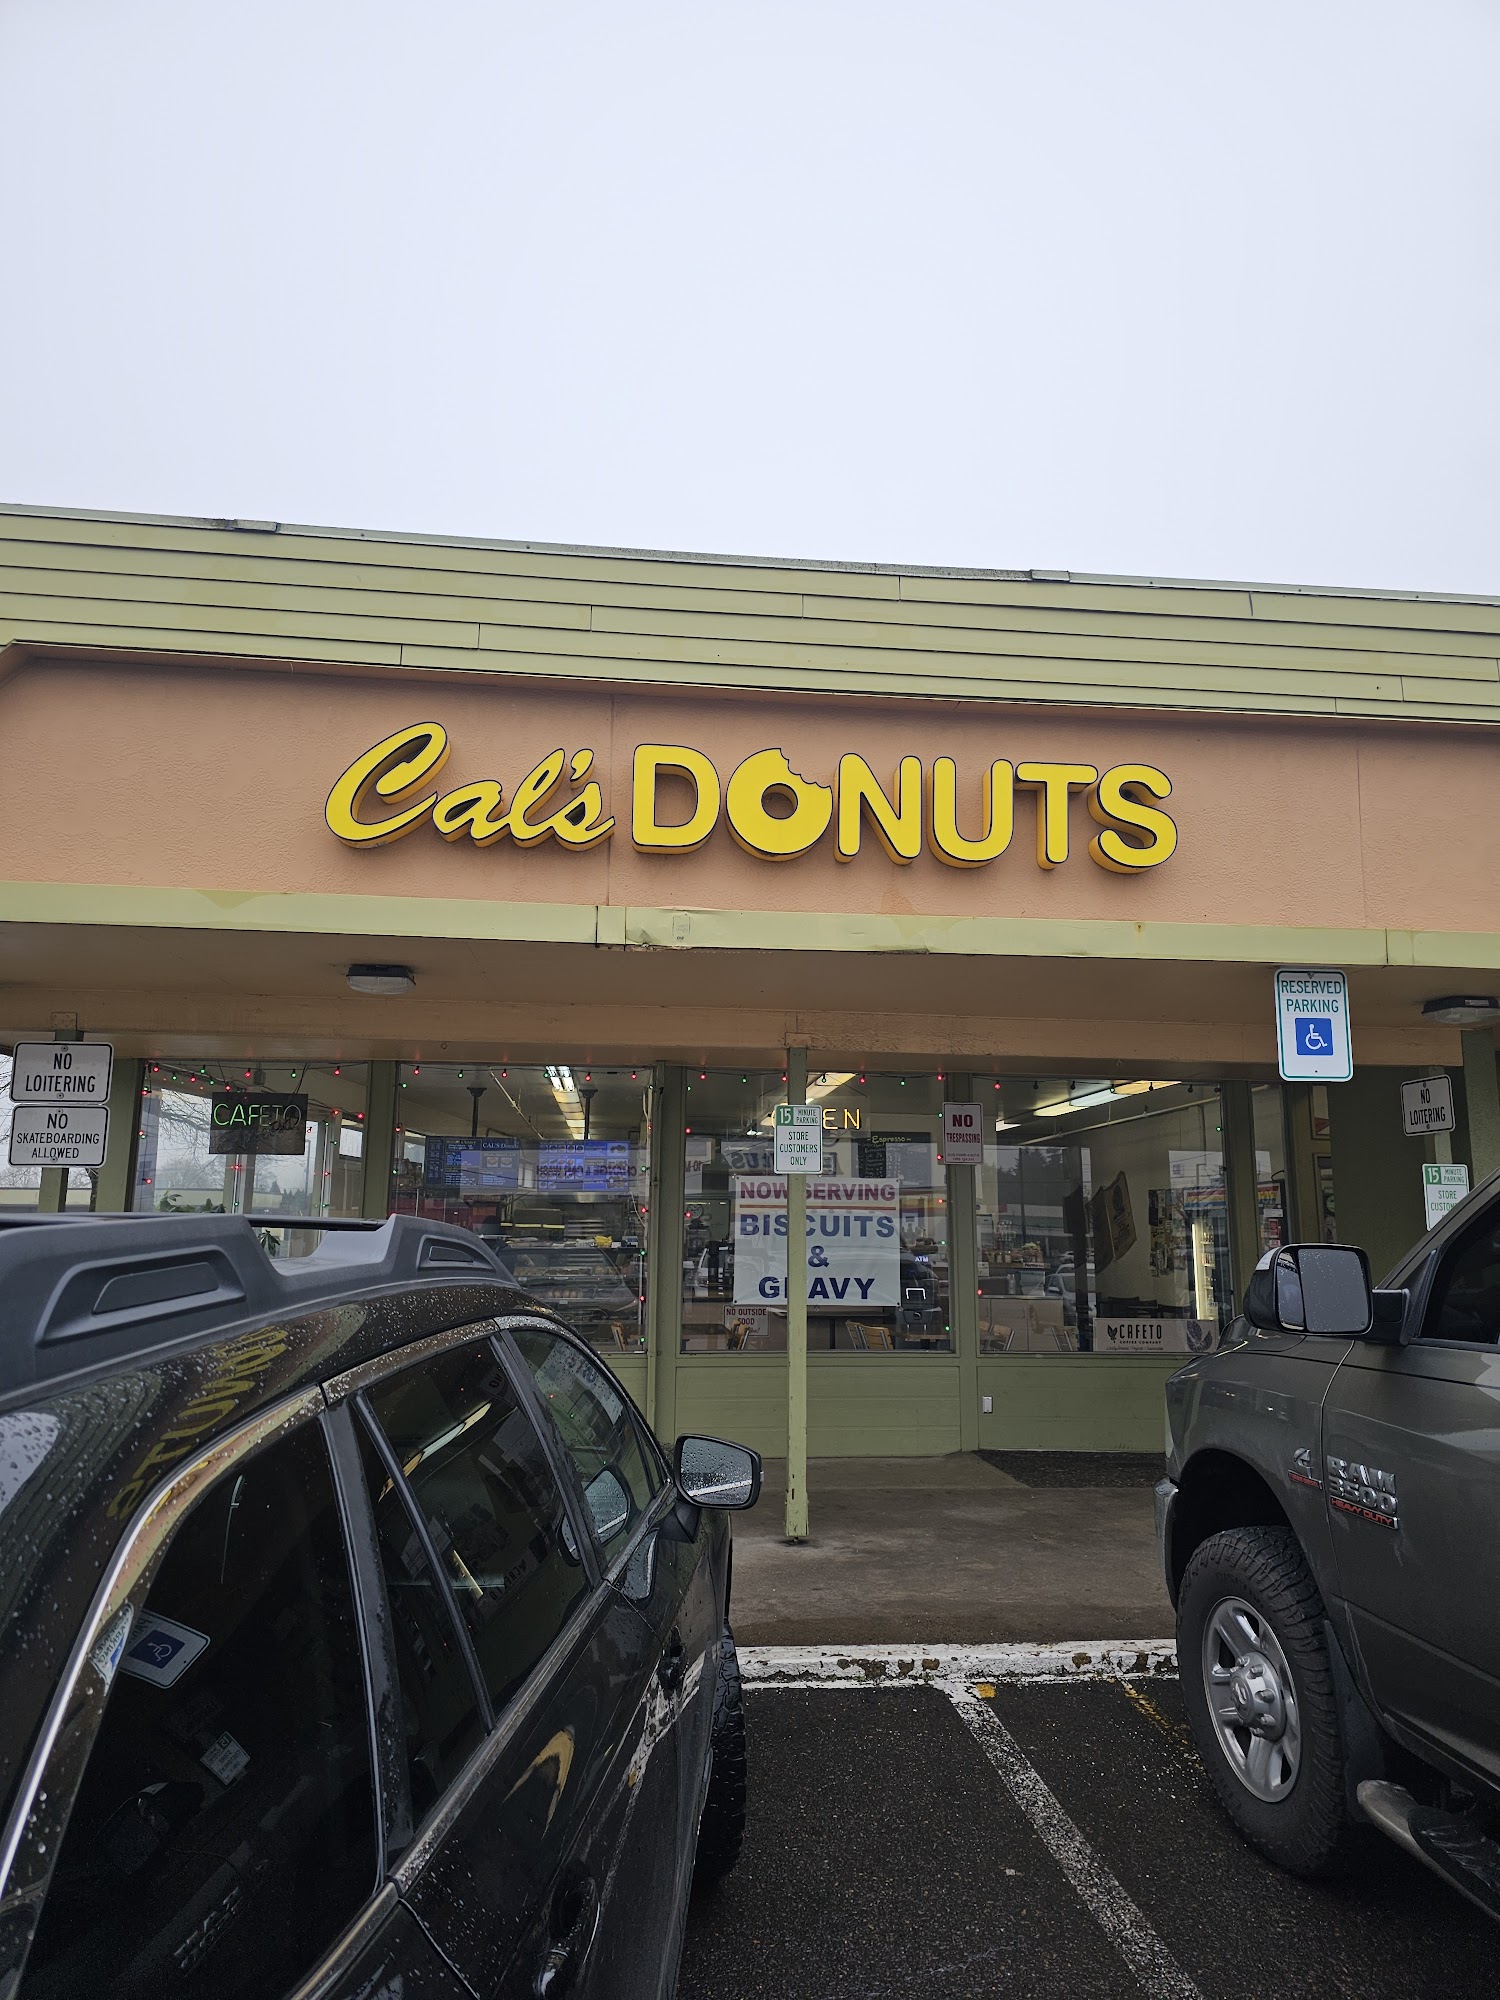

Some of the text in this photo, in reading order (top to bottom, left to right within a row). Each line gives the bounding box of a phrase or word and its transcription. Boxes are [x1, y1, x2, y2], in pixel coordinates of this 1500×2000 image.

[325, 721, 1179, 873] Cal's DONUTS
[1281, 980, 1342, 995] RESERVED
[1286, 998, 1339, 1013] PARKING
[53, 1052, 72, 1070] NO
[25, 1074, 96, 1093] LOITERING
[1420, 1088, 1431, 1105] NO
[213, 1103, 302, 1127] CAFETO
[779, 1107, 793, 1125] 15
[798, 1108, 817, 1117] MINUTE
[1409, 1106, 1446, 1126] LOITERING
[46, 1112, 68, 1130] NO
[795, 1116, 819, 1125] PARKING
[952, 1114, 974, 1128] NO
[16, 1132, 100, 1146] SKATEBOARDING
[788, 1131, 809, 1142] STORE
[872, 1135, 906, 1145] Espresso
[946, 1132, 981, 1145] TRESPASSING
[31, 1145, 80, 1160] ALLOWED
[779, 1143, 818, 1154] CUSTOMERS
[790, 1155, 808, 1167] ONLY
[1427, 1167, 1440, 1183] 15
[1444, 1168, 1463, 1176] MINUTE
[740, 1181, 788, 1199] NOW
[1437, 1190, 1457, 1199] STORE
[808, 1245, 830, 1268] &
[914, 1255, 929, 1263] ATM
[758, 1276, 876, 1300] GAVY
[726, 1308, 767, 1316] NO OUTSIDE
[1119, 1324, 1162, 1339] CAFETO
[1327, 1455, 1396, 1494] RAM
[1328, 1475, 1398, 1514] 3500
[1331, 1498, 1393, 1526] HEAVY DUTY
